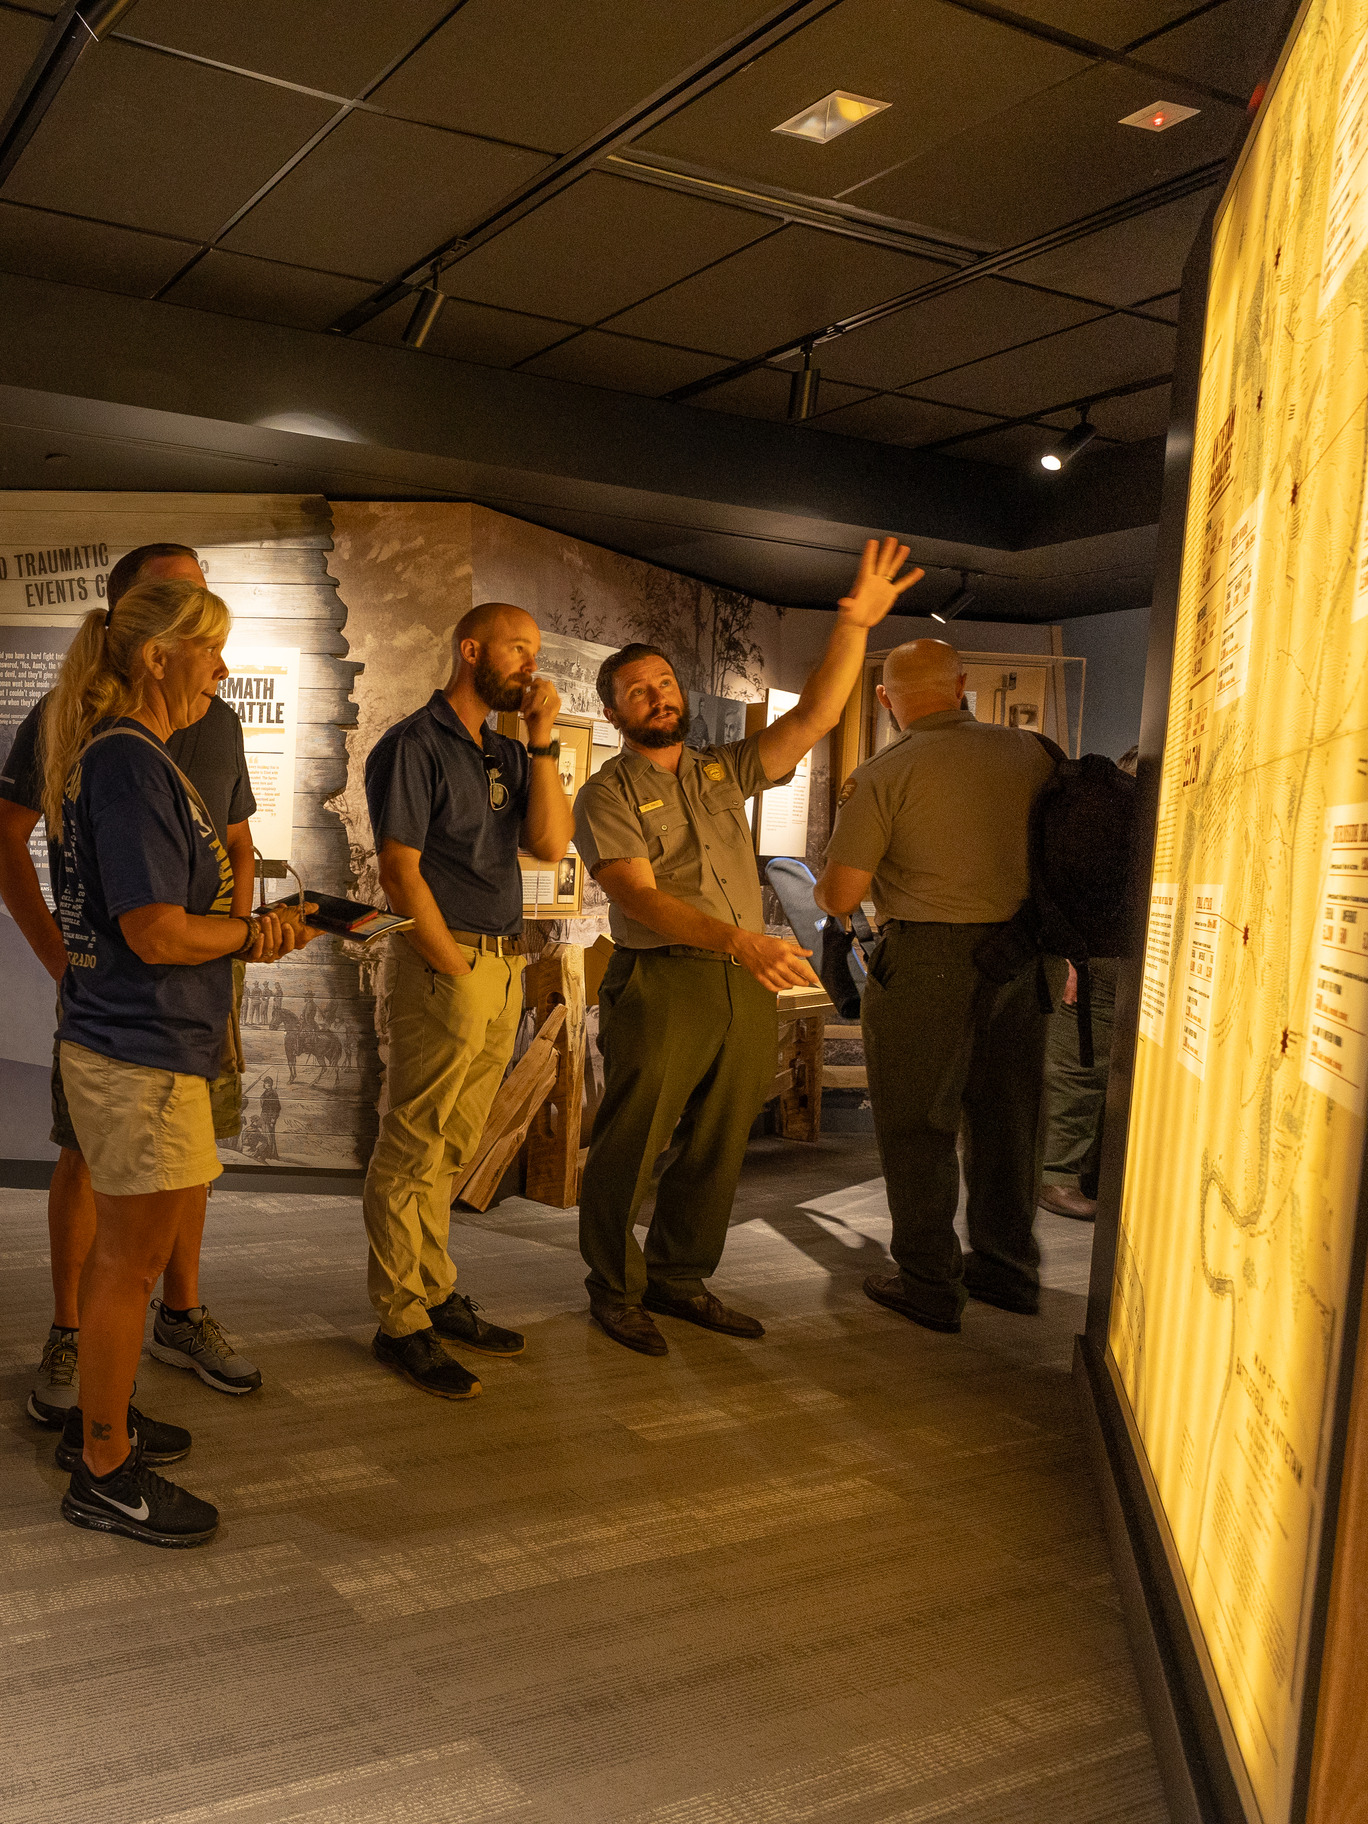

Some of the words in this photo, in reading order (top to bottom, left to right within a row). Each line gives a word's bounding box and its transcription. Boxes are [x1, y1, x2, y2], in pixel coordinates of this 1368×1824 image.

[13, 542, 109, 578] TRAUMATIC
[25, 576, 88, 607] EVENTS
[5, 652, 14, 660] you
[30, 652, 41, 660] hard
[24, 680, 36, 688] back
[7, 698, 20, 706] when
